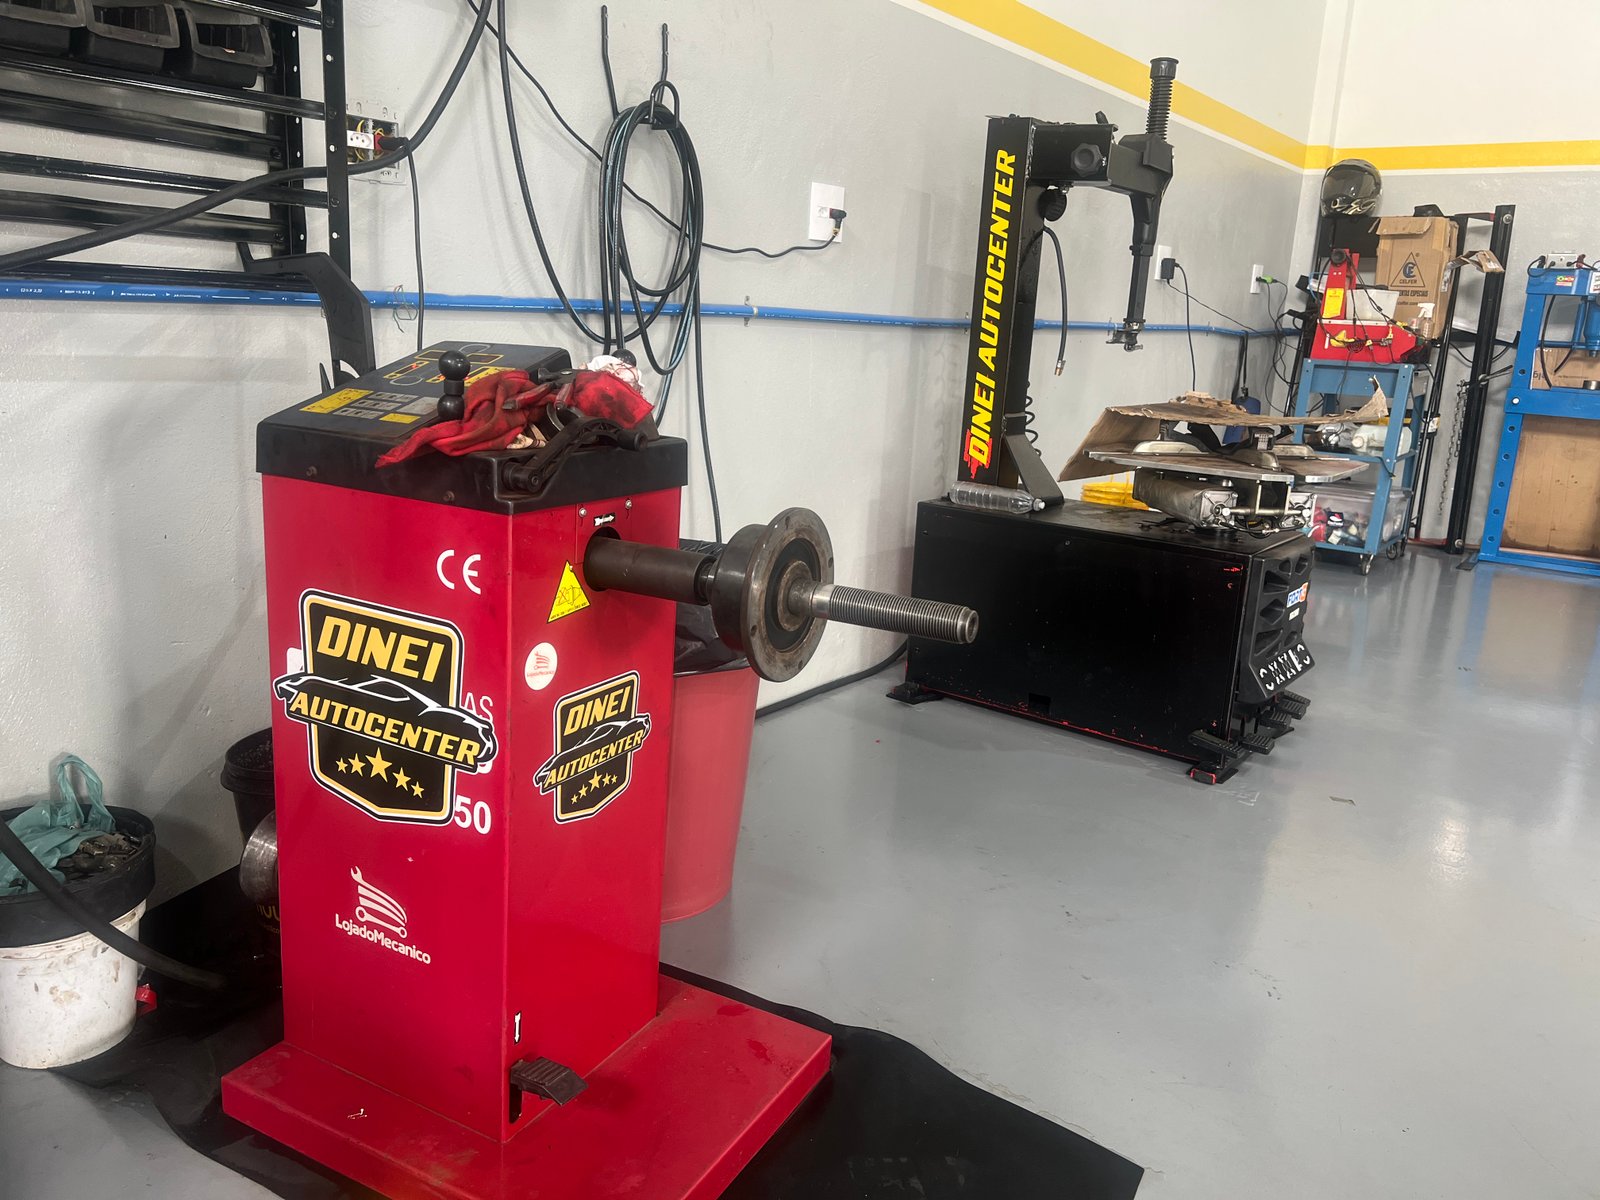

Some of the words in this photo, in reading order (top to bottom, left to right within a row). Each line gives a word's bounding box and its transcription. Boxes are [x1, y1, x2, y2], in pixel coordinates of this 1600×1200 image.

[978, 149, 1016, 372] AUTOCENTER
[968, 371, 996, 466] DINEI
[436, 549, 482, 595] CE
[317, 616, 445, 683] DINEI
[289, 691, 481, 765] AUTOCENTER
[564, 684, 631, 737] DINEI
[543, 729, 643, 787] AUTOCENTER
[454, 796, 492, 835] 50
[335, 913, 431, 965] LojadoMecanico
